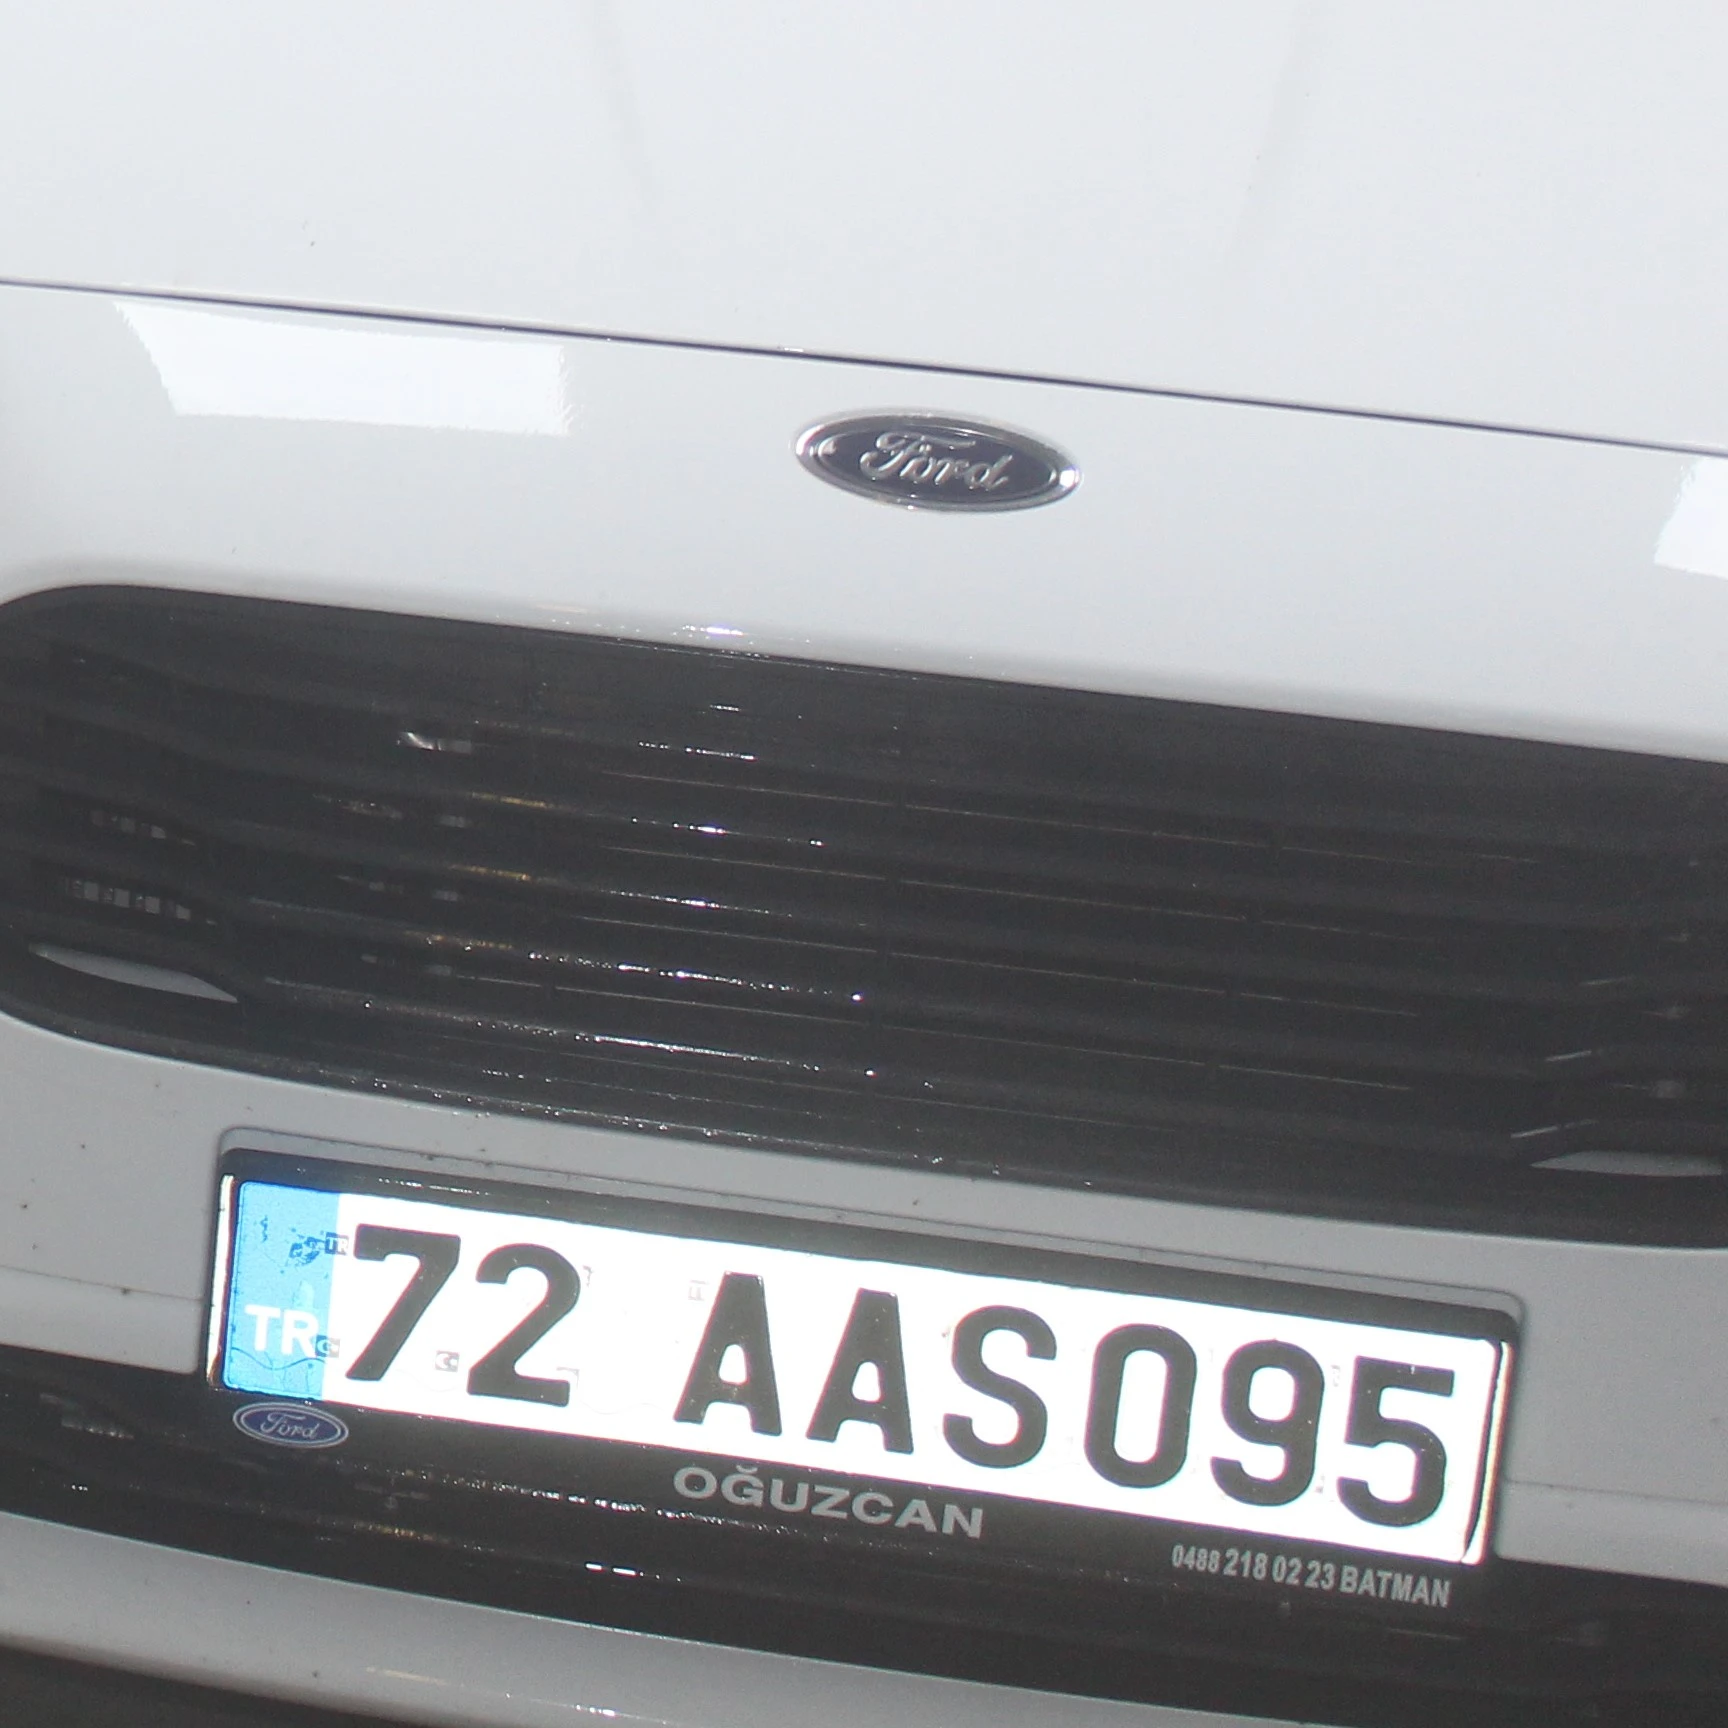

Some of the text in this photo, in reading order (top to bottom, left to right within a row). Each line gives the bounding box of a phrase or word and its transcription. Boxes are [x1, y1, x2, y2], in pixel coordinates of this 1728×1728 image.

[859, 431, 1013, 492] Ford
[245, 1303, 319, 1359] TR
[345, 1223, 581, 1407] 72
[259, 1411, 319, 1441] Ford
[673, 1465, 984, 1539] OĞUZCAN
[1171, 1543, 1451, 1608] 0488 218 02 23 BATMAN
